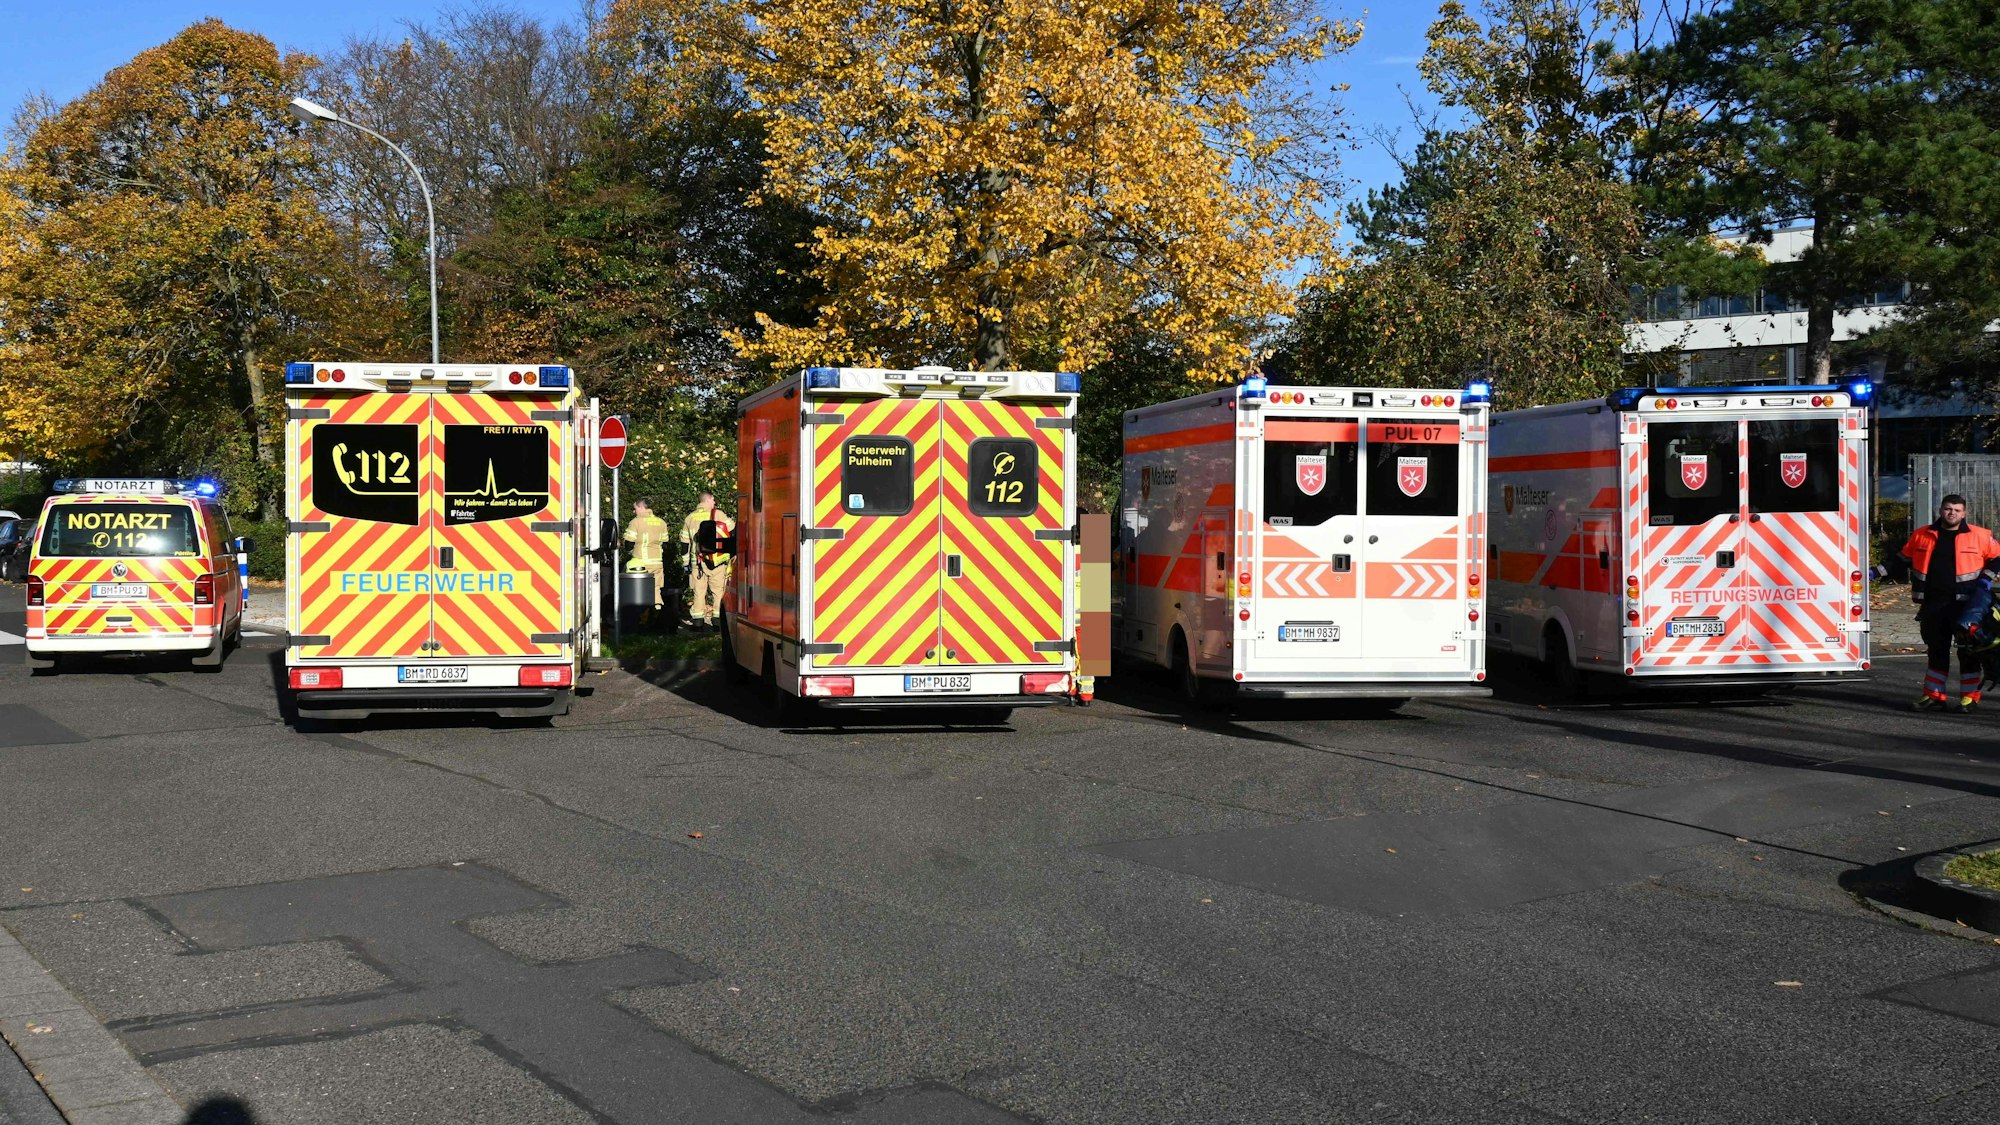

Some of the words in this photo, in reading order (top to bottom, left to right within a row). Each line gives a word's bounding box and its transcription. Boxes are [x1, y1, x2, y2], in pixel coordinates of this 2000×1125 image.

[1385, 426, 1418, 440] PUL
[1423, 427, 1442, 440] 07
[848, 445, 906, 456] Feuerwehr
[355, 450, 412, 484] 112
[848, 456, 892, 466] Pulheim
[1151, 466, 1178, 486] Malteser
[94, 481, 156, 490] NOTARZT
[984, 480, 1024, 502] 112
[1516, 485, 1550, 506] Malteser
[68, 513, 172, 530] NOTARZT
[114, 532, 148, 548] 112
[342, 573, 514, 592] FEUERWEHR
[100, 586, 114, 594] BM
[120, 586, 130, 594] PU
[132, 586, 143, 594] 91
[1672, 588, 1818, 604] RETTUNGSWAGEN
[1285, 627, 1297, 638] BM
[1303, 627, 1316, 638] MH
[1316, 627, 1338, 638] 9837
[1673, 622, 1684, 634] BM
[1690, 622, 1702, 632] MH
[1702, 622, 1724, 632] 2831
[405, 668, 418, 678] BM
[425, 668, 438, 678] RD
[441, 668, 466, 678] 6837
[912, 677, 926, 688] BM
[933, 677, 948, 688] PU
[950, 676, 970, 688] 832
